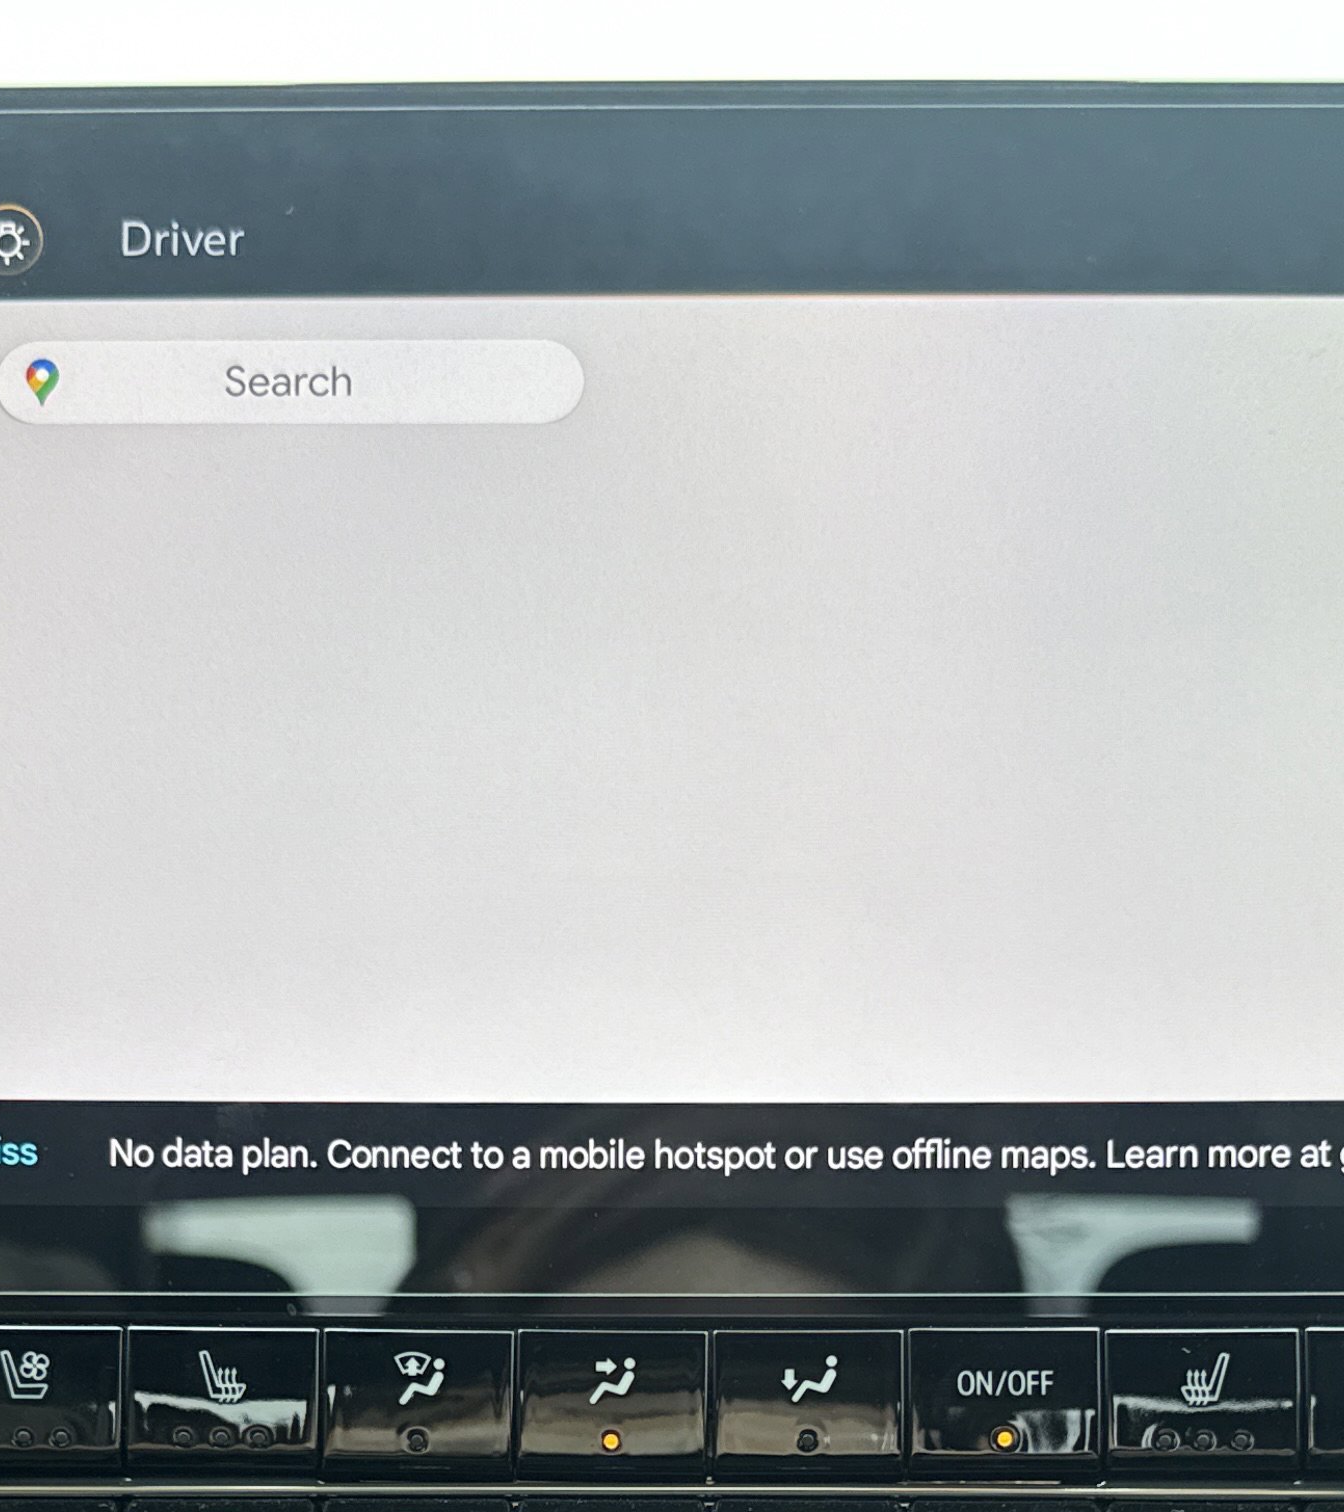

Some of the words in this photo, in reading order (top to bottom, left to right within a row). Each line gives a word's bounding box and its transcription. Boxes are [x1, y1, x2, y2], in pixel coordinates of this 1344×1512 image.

[121, 219, 246, 258] Driver
[224, 364, 354, 400] Search
[109, 1138, 155, 1170] No
[162, 1137, 235, 1171] data
[242, 1137, 318, 1176] plan.
[327, 1138, 462, 1171] Connect
[469, 1141, 505, 1171] to
[511, 1147, 532, 1171] a
[539, 1138, 645, 1171] mobile
[654, 1138, 776, 1176] hotspot
[784, 1145, 817, 1170] or
[828, 1145, 883, 1170] use
[892, 1138, 992, 1170] offline
[1001, 1145, 1096, 1176] maps.
[1106, 1138, 1198, 1170] Learn
[1208, 1144, 1292, 1170] more
[1299, 1139, 1332, 1169] at
[957, 1369, 1053, 1397] ON/OFF
